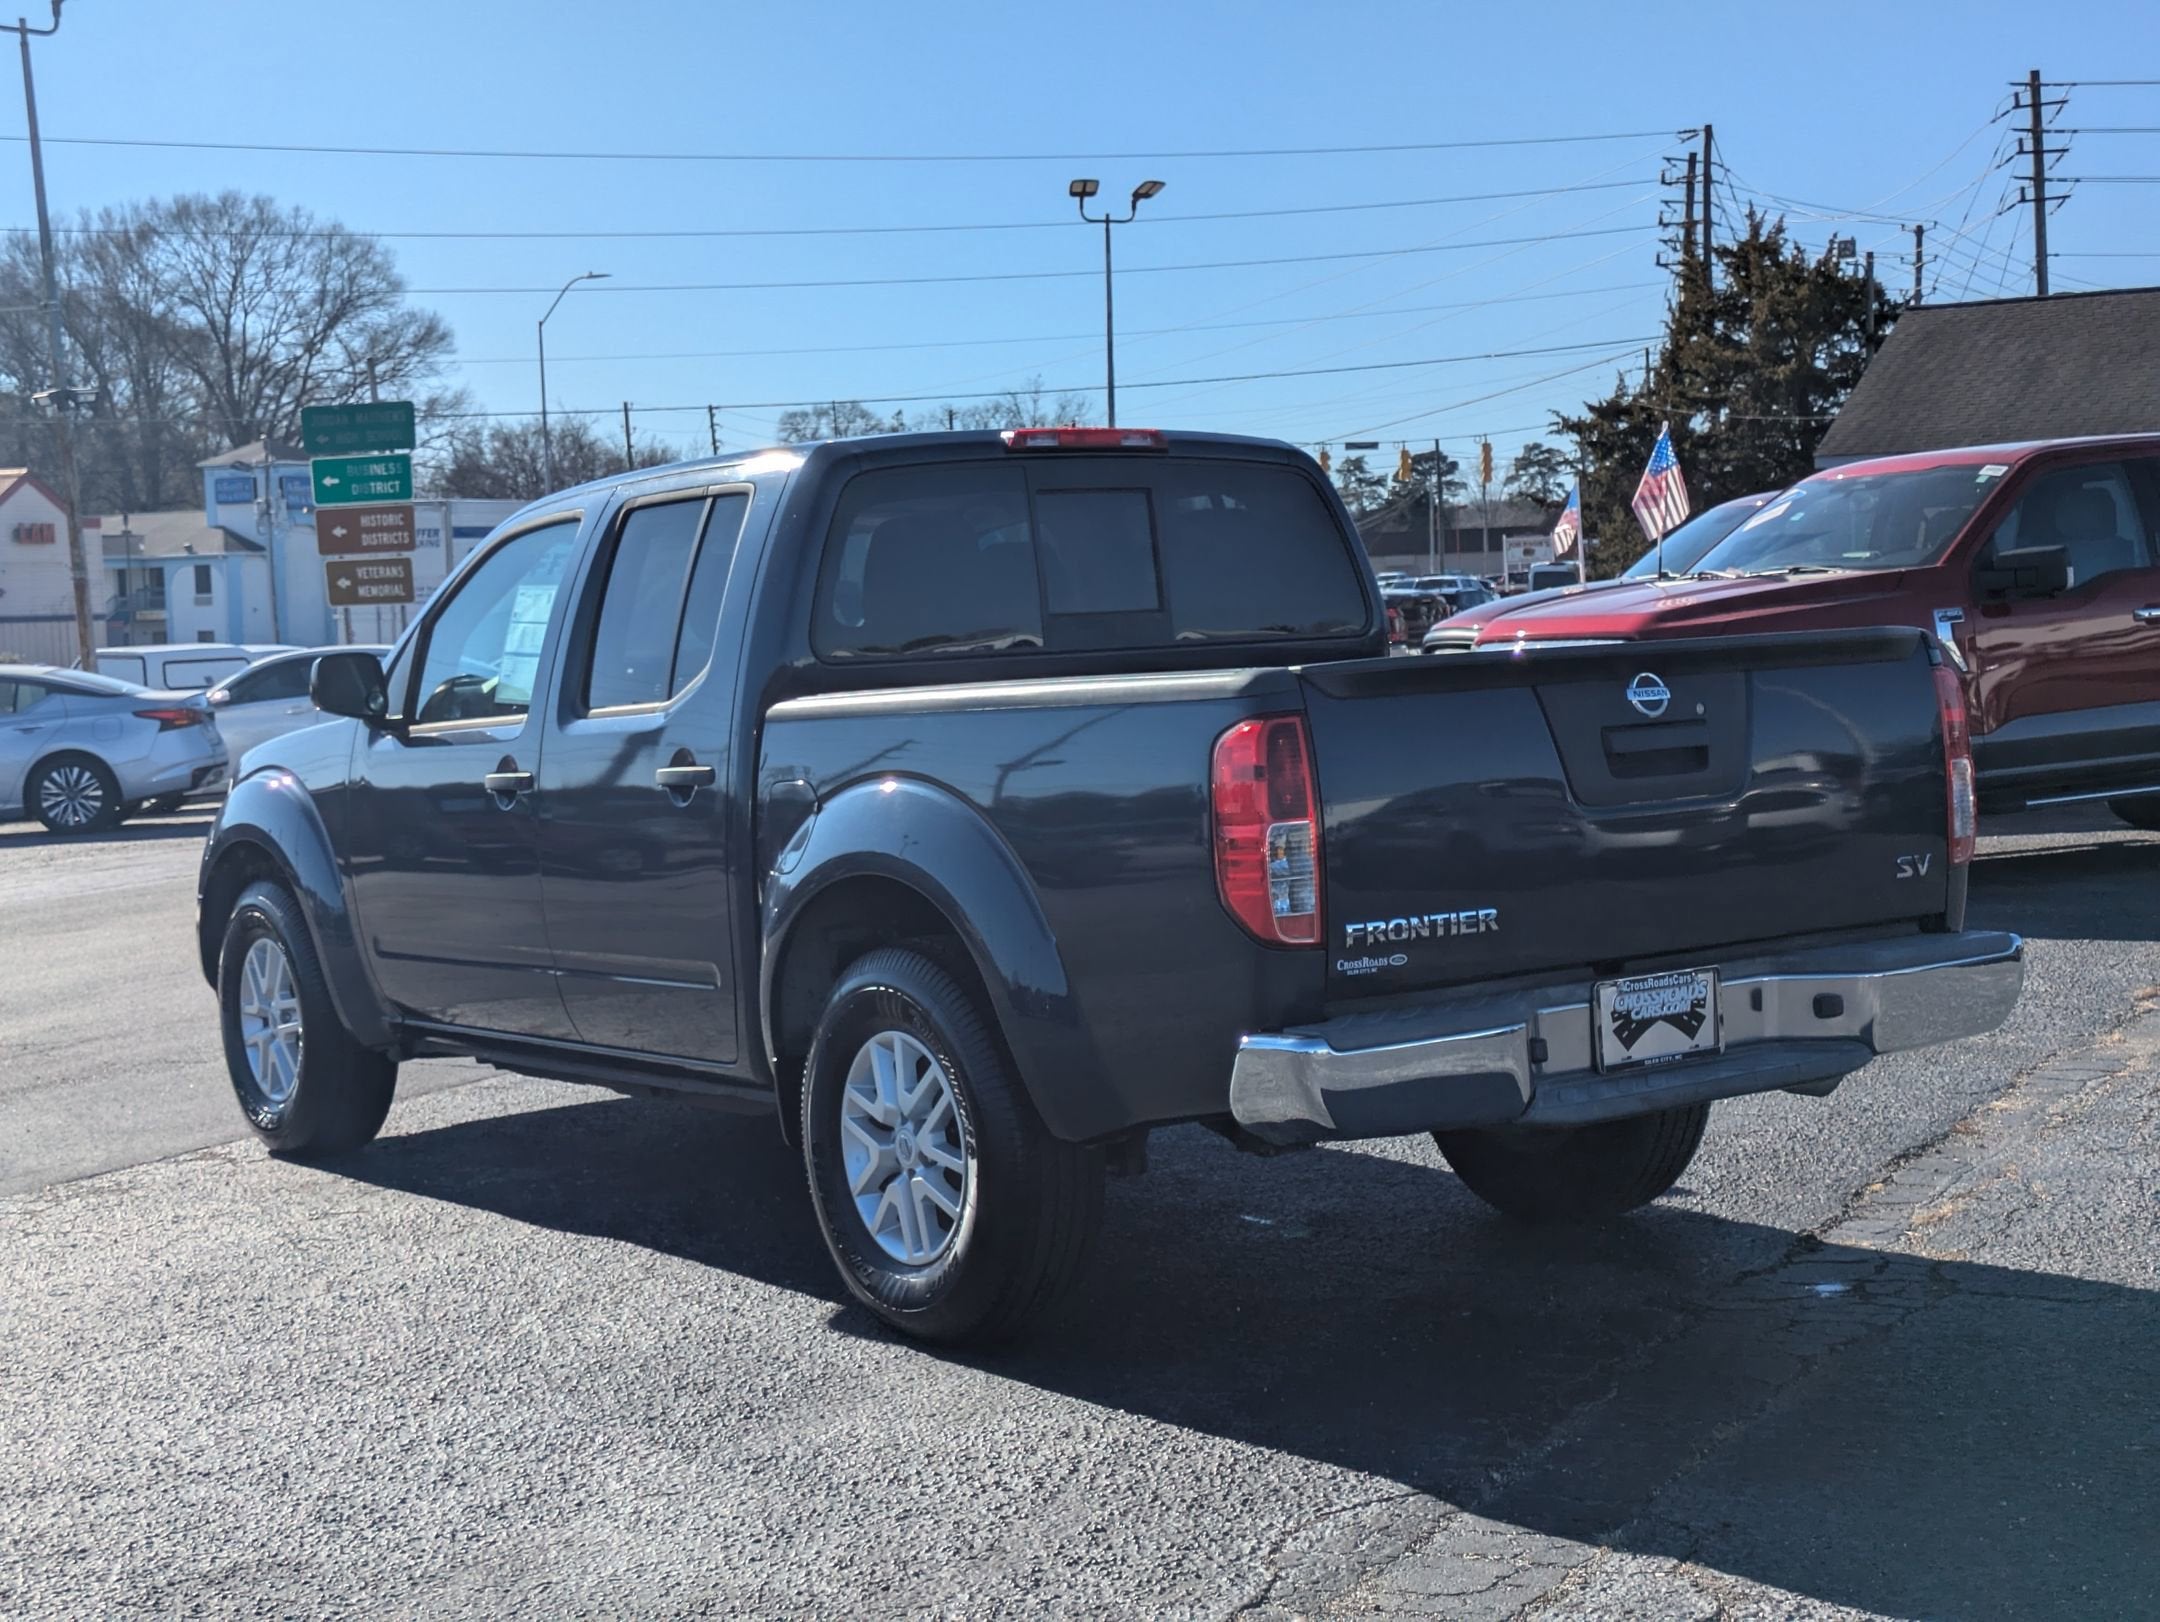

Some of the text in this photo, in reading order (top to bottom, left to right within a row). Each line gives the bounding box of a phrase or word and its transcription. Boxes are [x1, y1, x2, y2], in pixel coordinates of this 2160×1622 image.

[346, 462, 403, 477] BUSINESS
[351, 480, 401, 495] DISTRICT
[360, 513, 404, 527] HISTORIC
[361, 532, 410, 546] DISTRICTS
[356, 565, 405, 579] VETERANS
[357, 583, 406, 597] MEMORIAL
[1632, 689, 1668, 697] NISSAN
[1896, 853, 1932, 878] SV
[1345, 907, 1499, 949] FRONTIER
[1624, 973, 1692, 992] CrossRoadsCars
[1614, 980, 1708, 1012] CROSSROADS
[1631, 1000, 1691, 1021] CARS.COM
